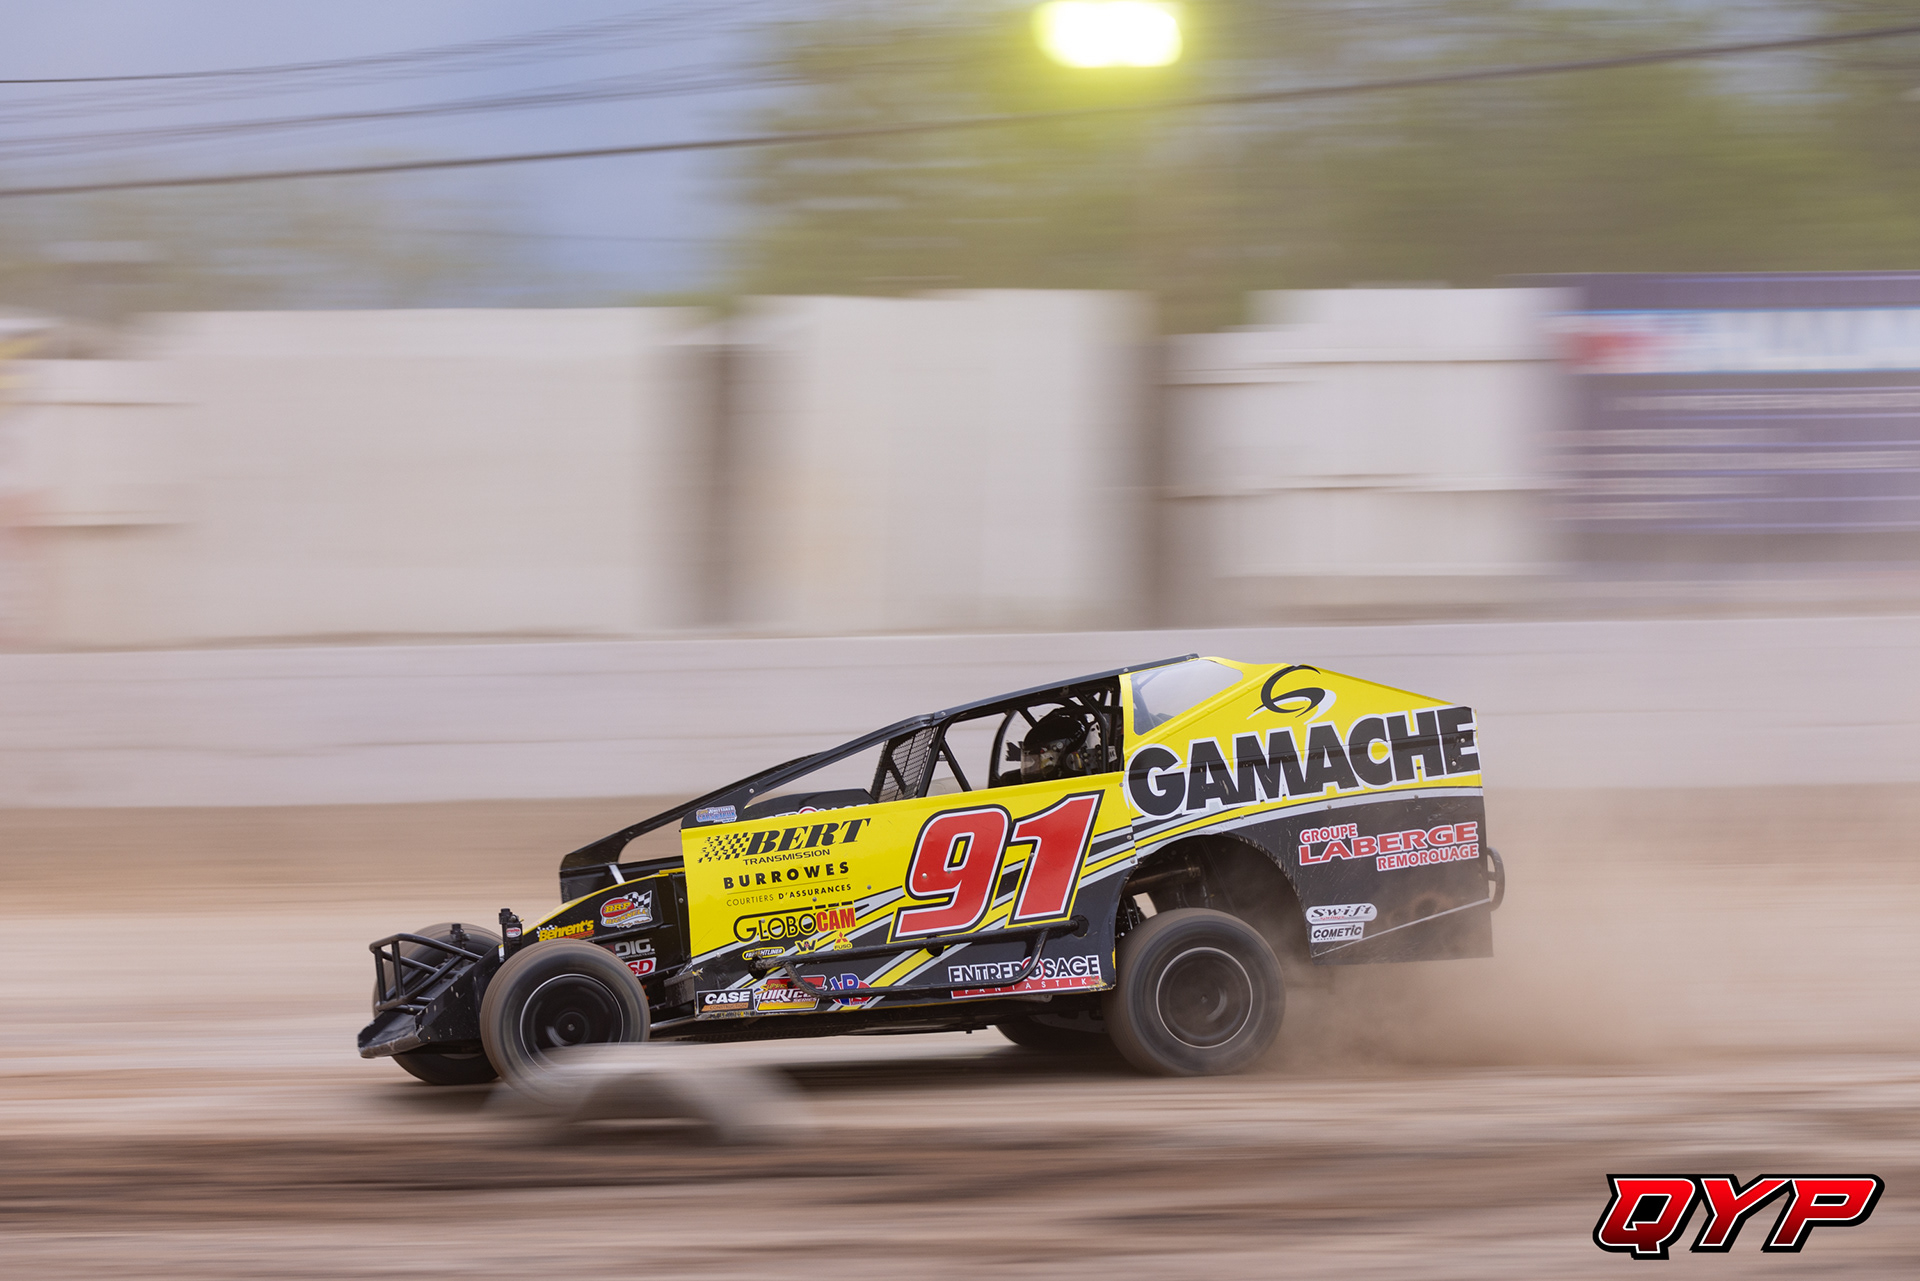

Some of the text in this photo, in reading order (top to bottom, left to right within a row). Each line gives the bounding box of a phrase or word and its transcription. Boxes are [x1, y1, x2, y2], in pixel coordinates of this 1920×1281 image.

[1125, 706, 1482, 820] GAMACHE
[743, 818, 871, 857] BERT
[1299, 823, 1358, 844] GROUPE
[1299, 821, 1478, 866] LABERGE
[743, 849, 830, 866] TRANSMISSION
[886, 789, 1105, 943] 91
[1376, 844, 1479, 872] REMORQUAGE
[723, 861, 850, 890] BURROWES
[605, 901, 632, 913] BRP
[726, 883, 852, 907] COURTIERS D'ASSURANCES
[539, 920, 594, 942] Behrent's
[733, 900, 856, 942] GLOBOCAM
[1313, 925, 1363, 939] COMETIC
[705, 991, 751, 1005] CASE
